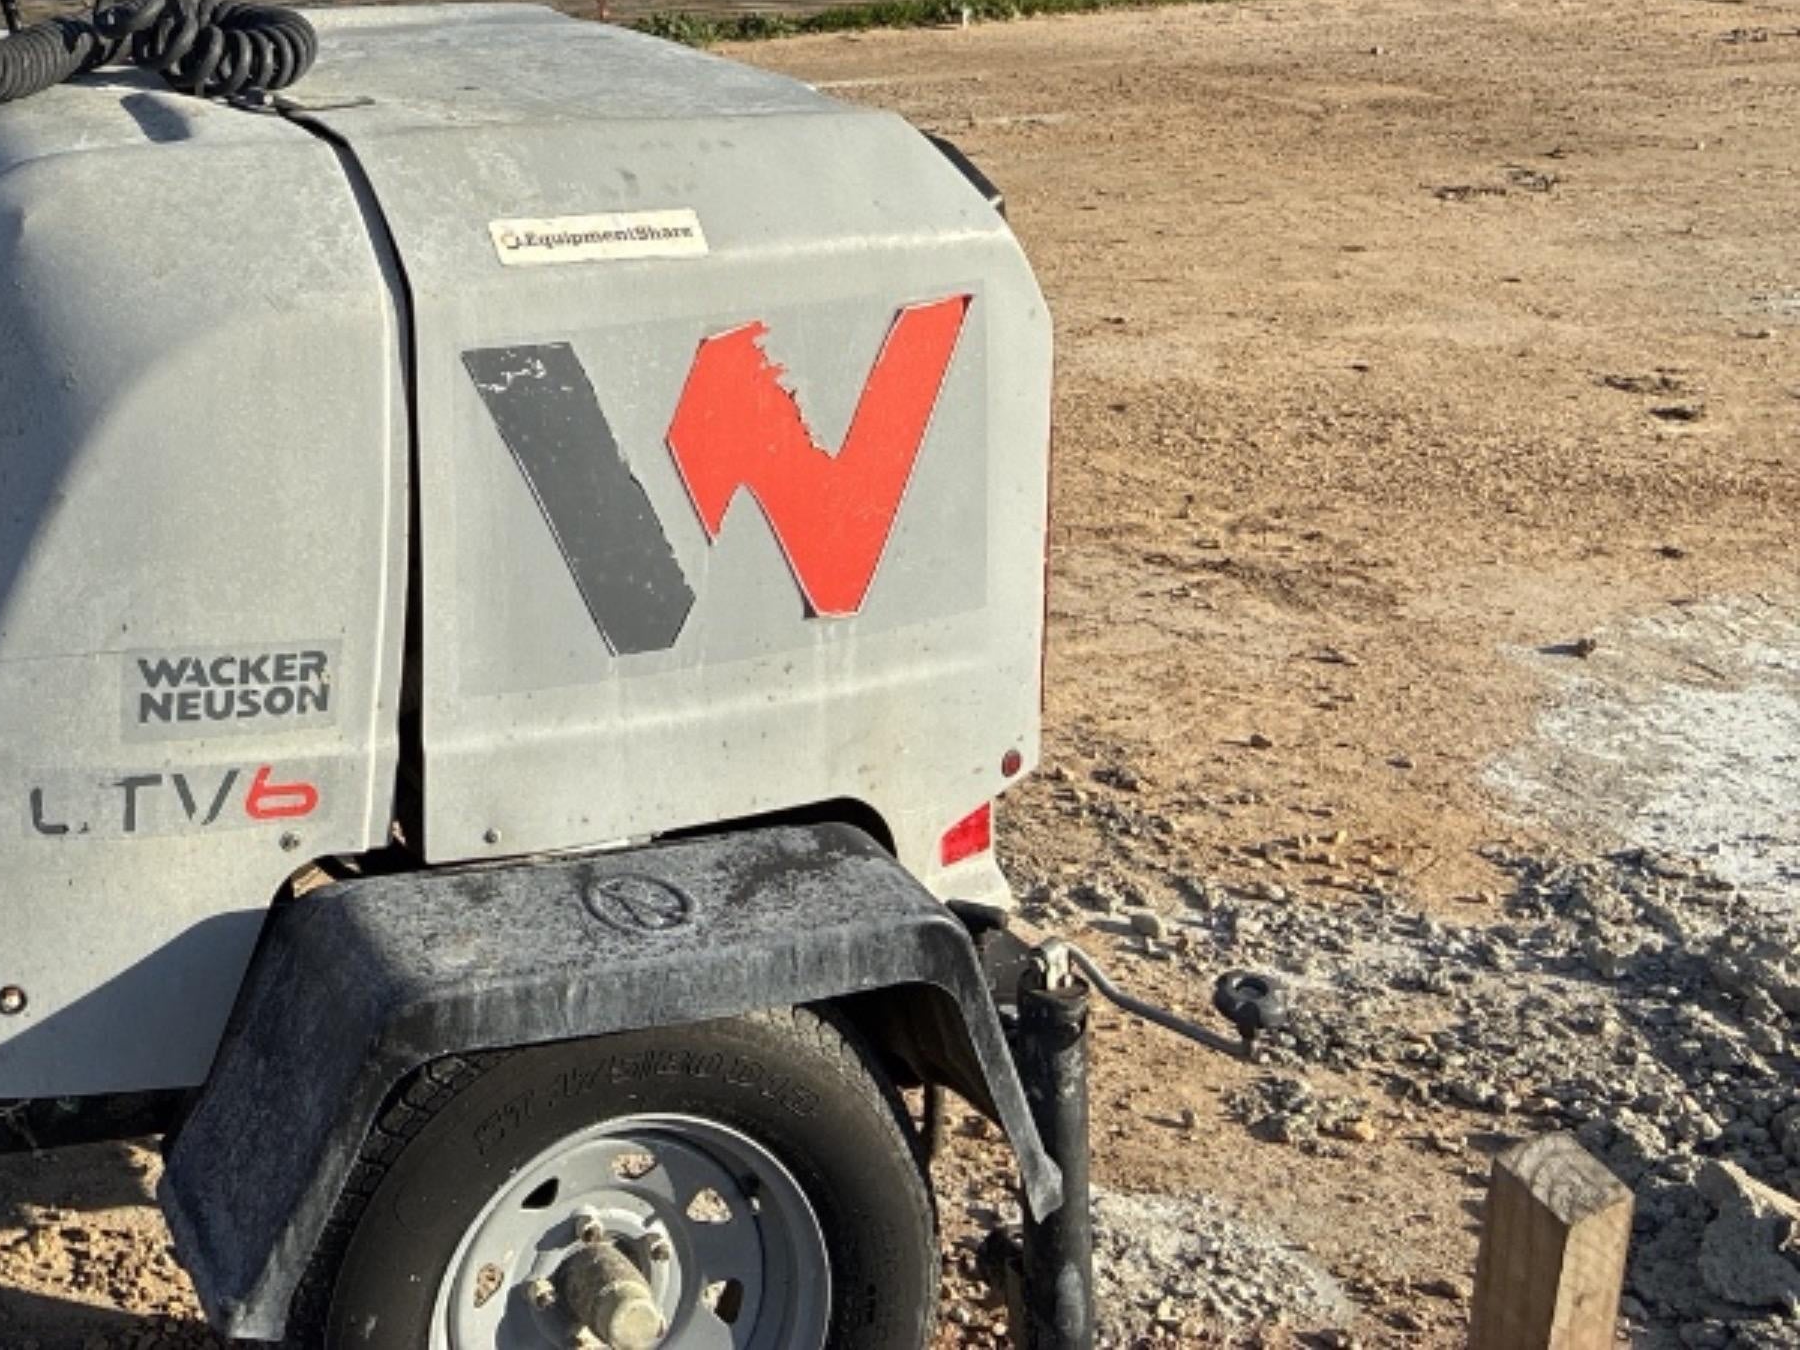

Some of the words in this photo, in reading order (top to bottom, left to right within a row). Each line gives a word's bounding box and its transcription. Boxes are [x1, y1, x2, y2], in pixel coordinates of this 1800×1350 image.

[523, 224, 695, 249] EquipmentShare
[136, 650, 329, 688] WACKER
[138, 684, 330, 723] NEUSON
